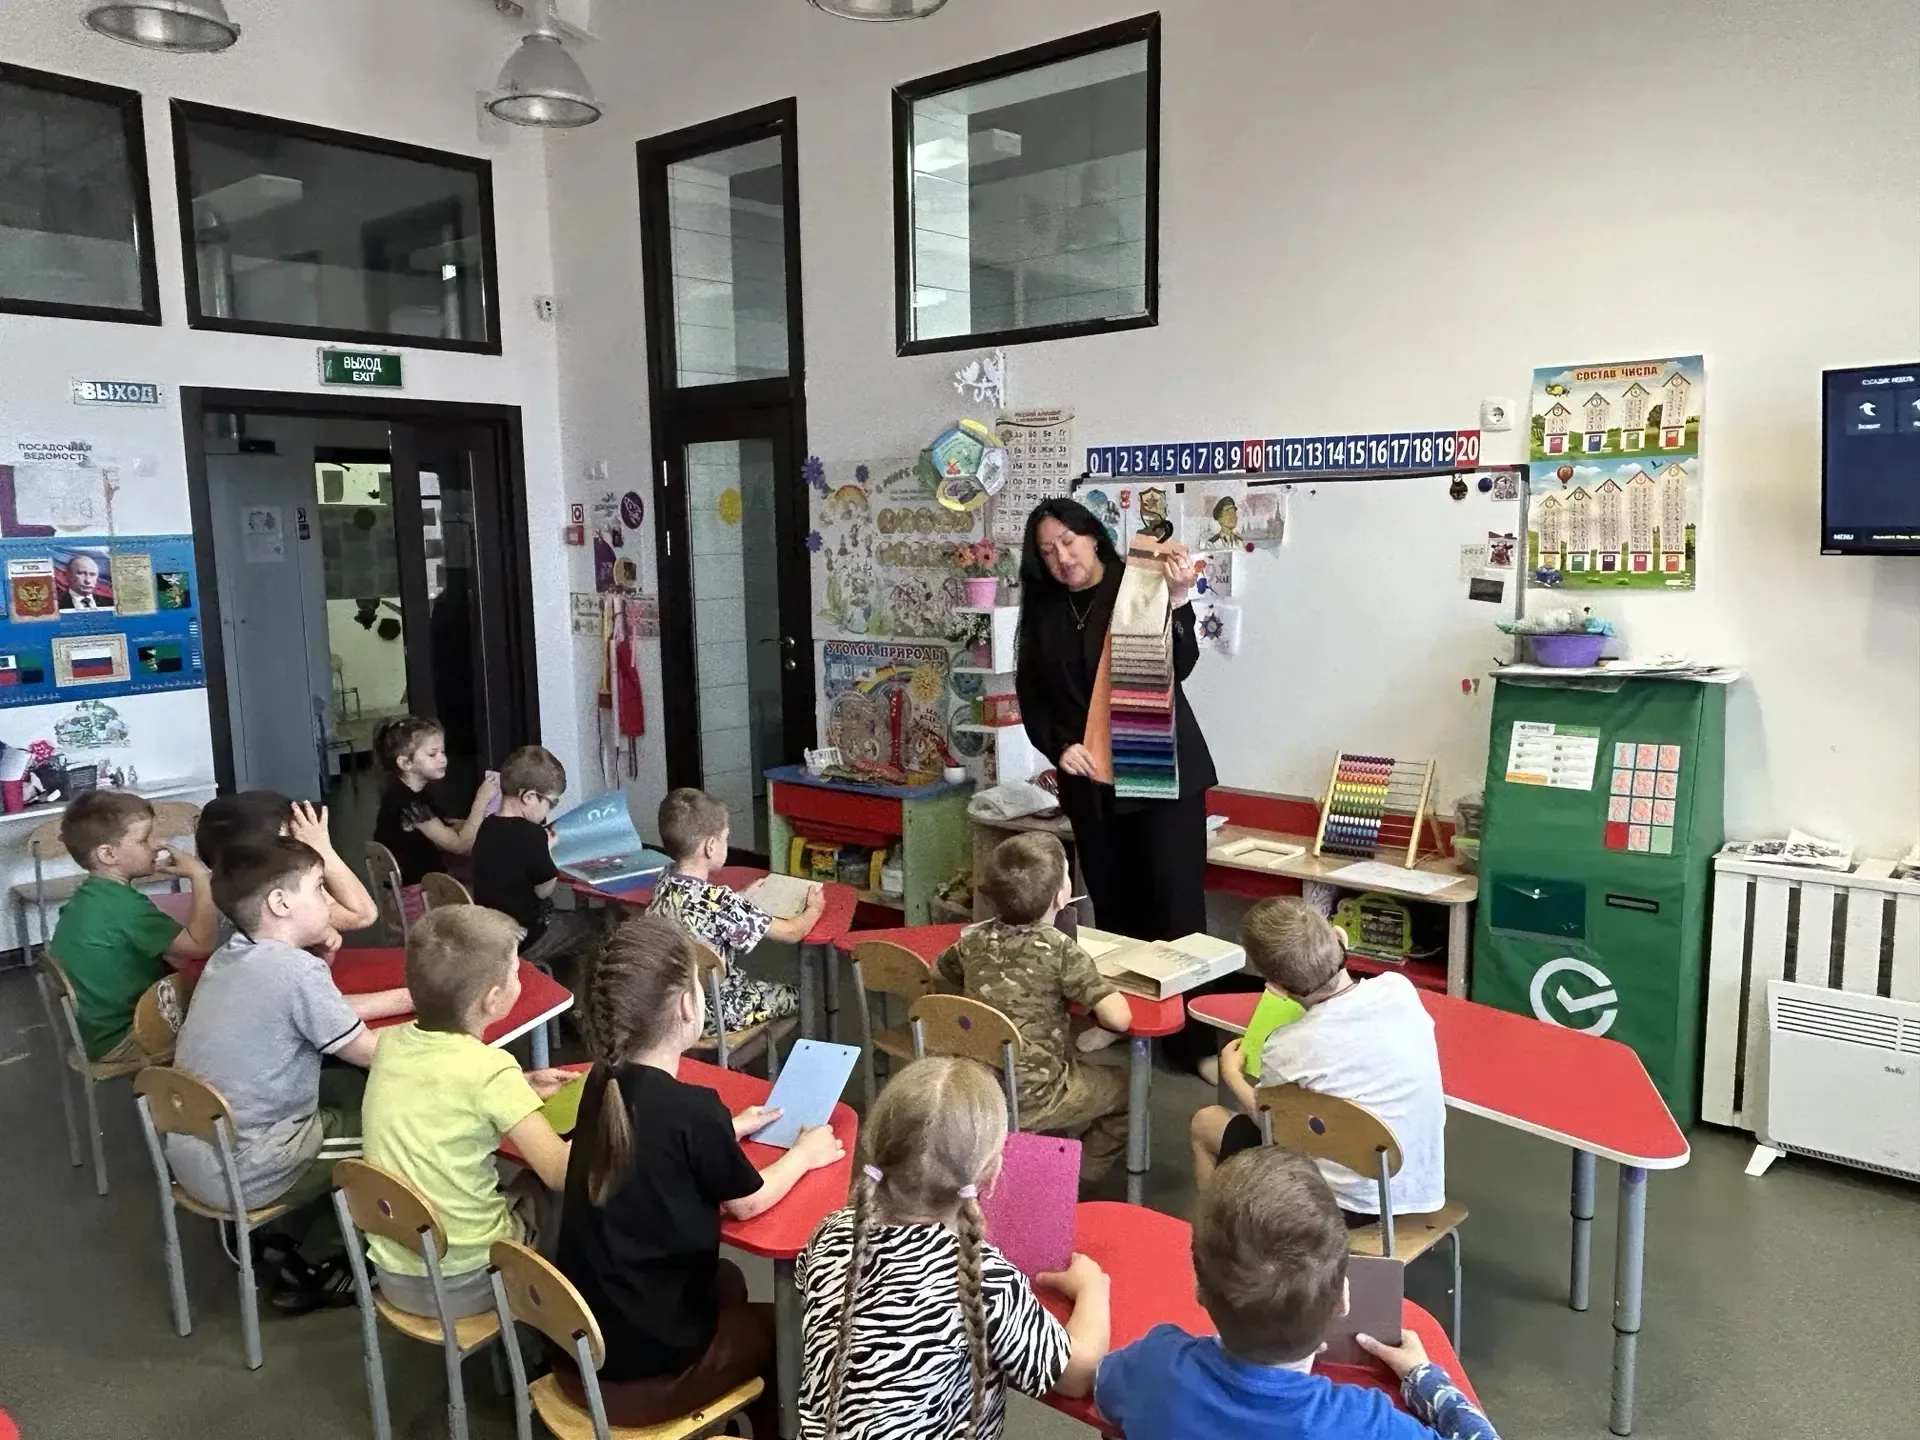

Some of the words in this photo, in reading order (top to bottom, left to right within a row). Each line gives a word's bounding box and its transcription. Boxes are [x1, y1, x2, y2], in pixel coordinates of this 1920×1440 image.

[343, 356, 382, 372] ВЫХОД
[352, 371, 375, 382] EXIT
[1576, 368, 1616, 381] СОСТАВ
[1621, 366, 1658, 377] ЧИСЛА
[82, 382, 154, 403] ВЫХОД
[24, 452, 89, 460] ВЕДОМОСТЬ
[1090, 453, 1099, 473] 0
[1105, 452, 1112, 473] 1
[1119, 452, 1128, 472] 2
[1134, 451, 1143, 472] 3
[1150, 450, 1160, 470] 4
[1166, 450, 1175, 470] 5
[1181, 449, 1191, 470] 6
[1198, 448, 1207, 469] 7
[1214, 448, 1224, 469] 8
[1230, 447, 1240, 468] 9
[1246, 446, 1262, 468] 10
[1266, 445, 1280, 467] 11
[1286, 444, 1302, 466] 12
[1306, 443, 1322, 466] 13
[1327, 442, 1344, 465] 14
[1348, 441, 1365, 464] 15
[1369, 440, 1387, 464] 16
[1391, 439, 1409, 463] 17
[1413, 438, 1432, 462] 18
[1436, 437, 1455, 462] 19
[1457, 436, 1478, 461] 20
[826, 642, 875, 656] УГОЛОК
[880, 646, 945, 661] ПРИРОДЫ
